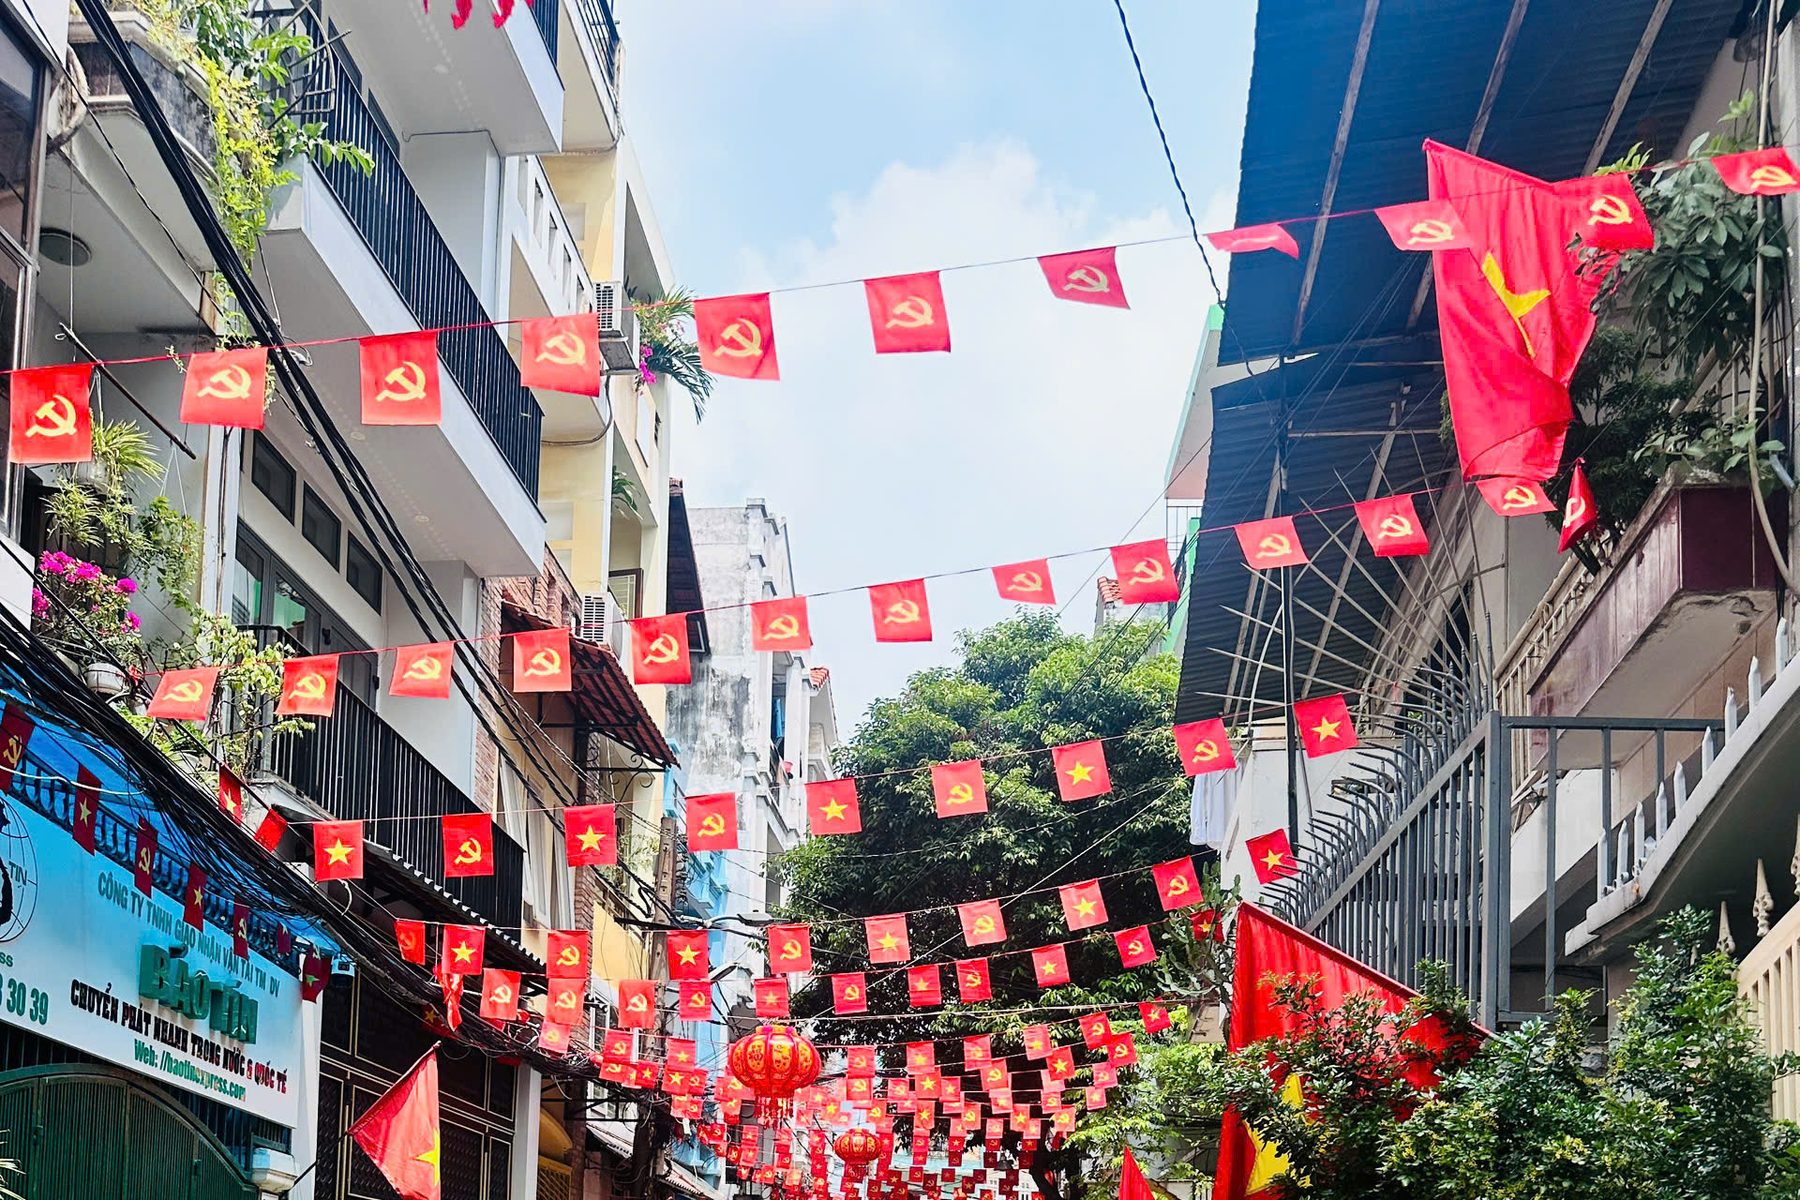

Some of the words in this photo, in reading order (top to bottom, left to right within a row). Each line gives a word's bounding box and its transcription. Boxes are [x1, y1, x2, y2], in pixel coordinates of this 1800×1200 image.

[98, 872, 128, 909] CÔNG
[131, 890, 145, 917] TY
[146, 900, 172, 935] TNHH
[175, 918, 196, 948] GIAO
[255, 966, 267, 991] TM
[270, 976, 280, 998] DV
[6, 978, 26, 1016] 30
[30, 987, 49, 1025] 39
[70, 978, 119, 1024] CHUYỂN
[122, 1001, 151, 1036] PHÁT
[153, 1015, 189, 1053] NHANH
[191, 1032, 221, 1067] TRONG
